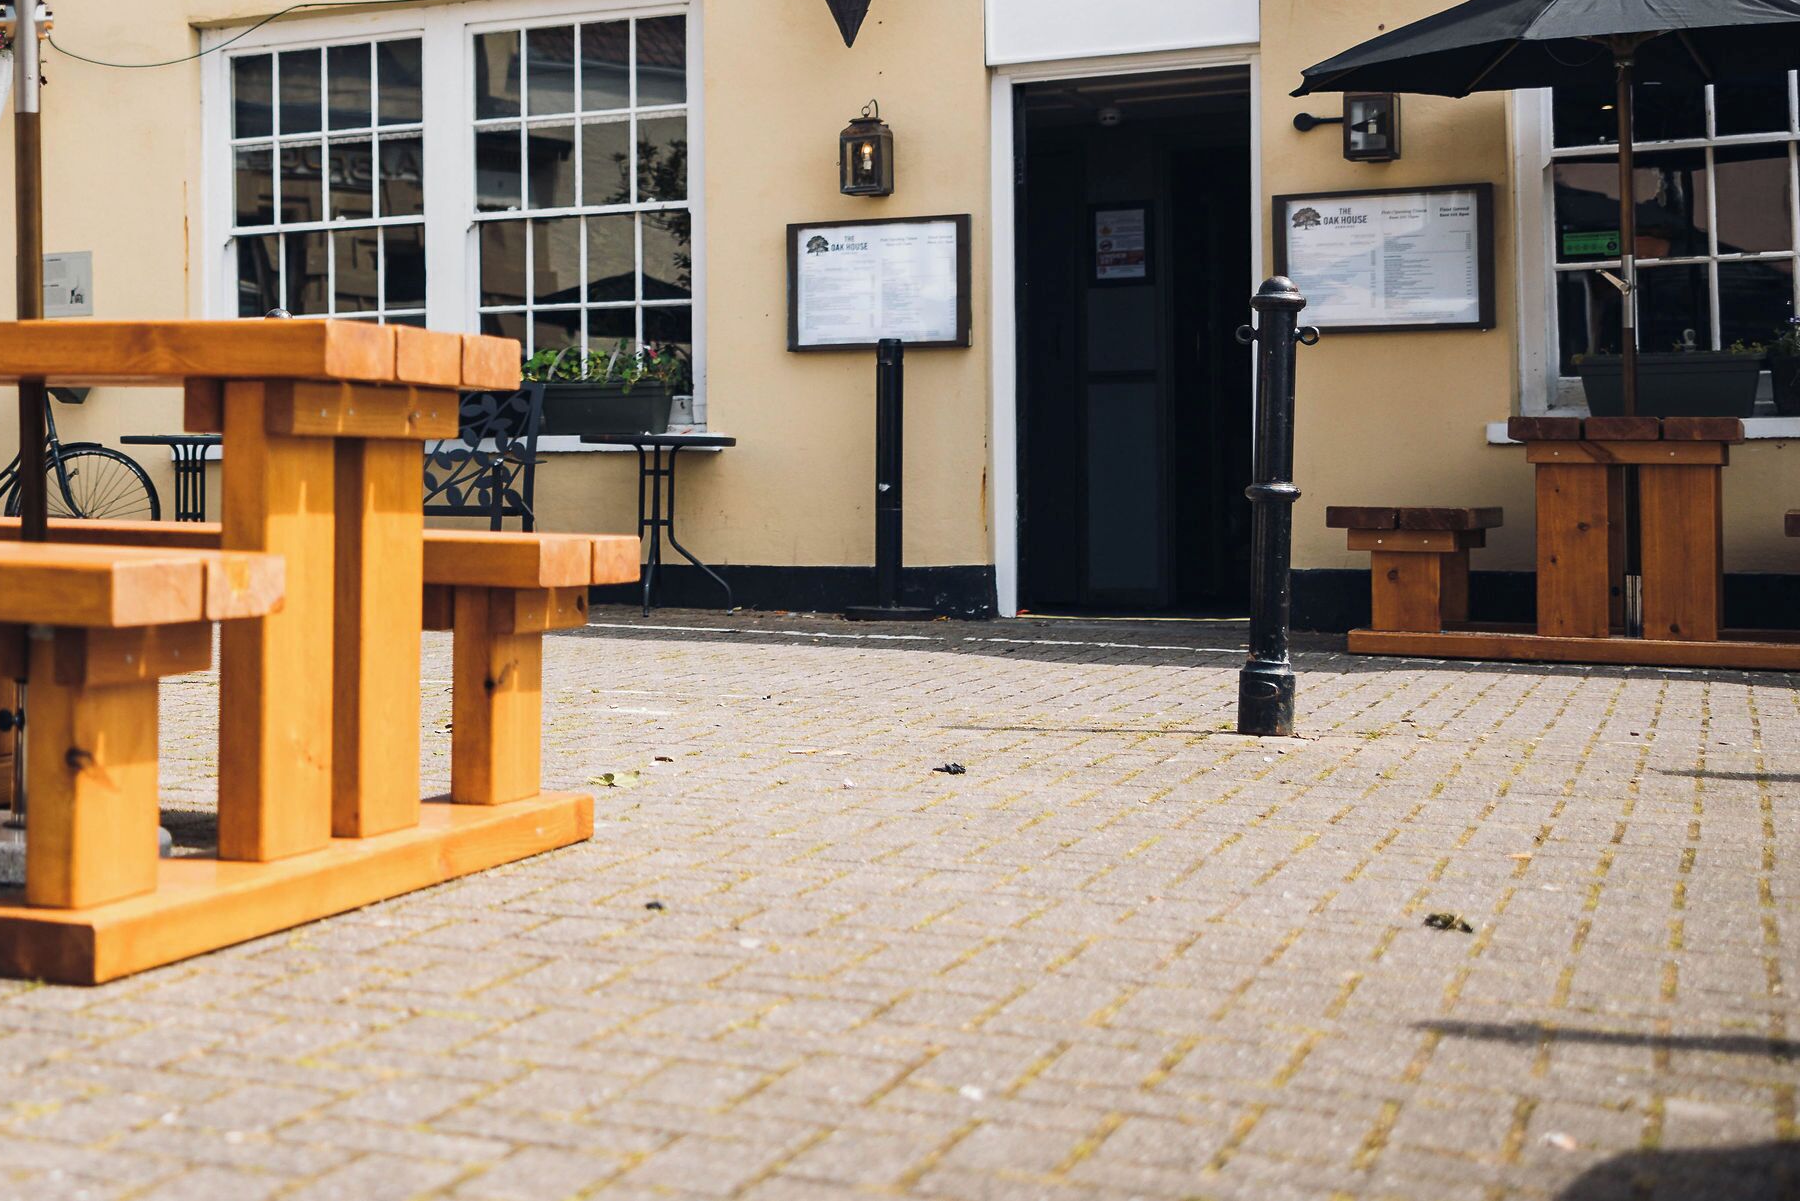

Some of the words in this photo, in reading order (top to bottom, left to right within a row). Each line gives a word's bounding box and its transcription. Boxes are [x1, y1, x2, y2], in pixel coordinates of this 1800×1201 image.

[1339, 207, 1352, 215] THE
[1323, 216, 1339, 225] OAK
[1341, 215, 1368, 224] HOUSE
[831, 243, 844, 252] OAK
[846, 242, 868, 251] HOUSE
